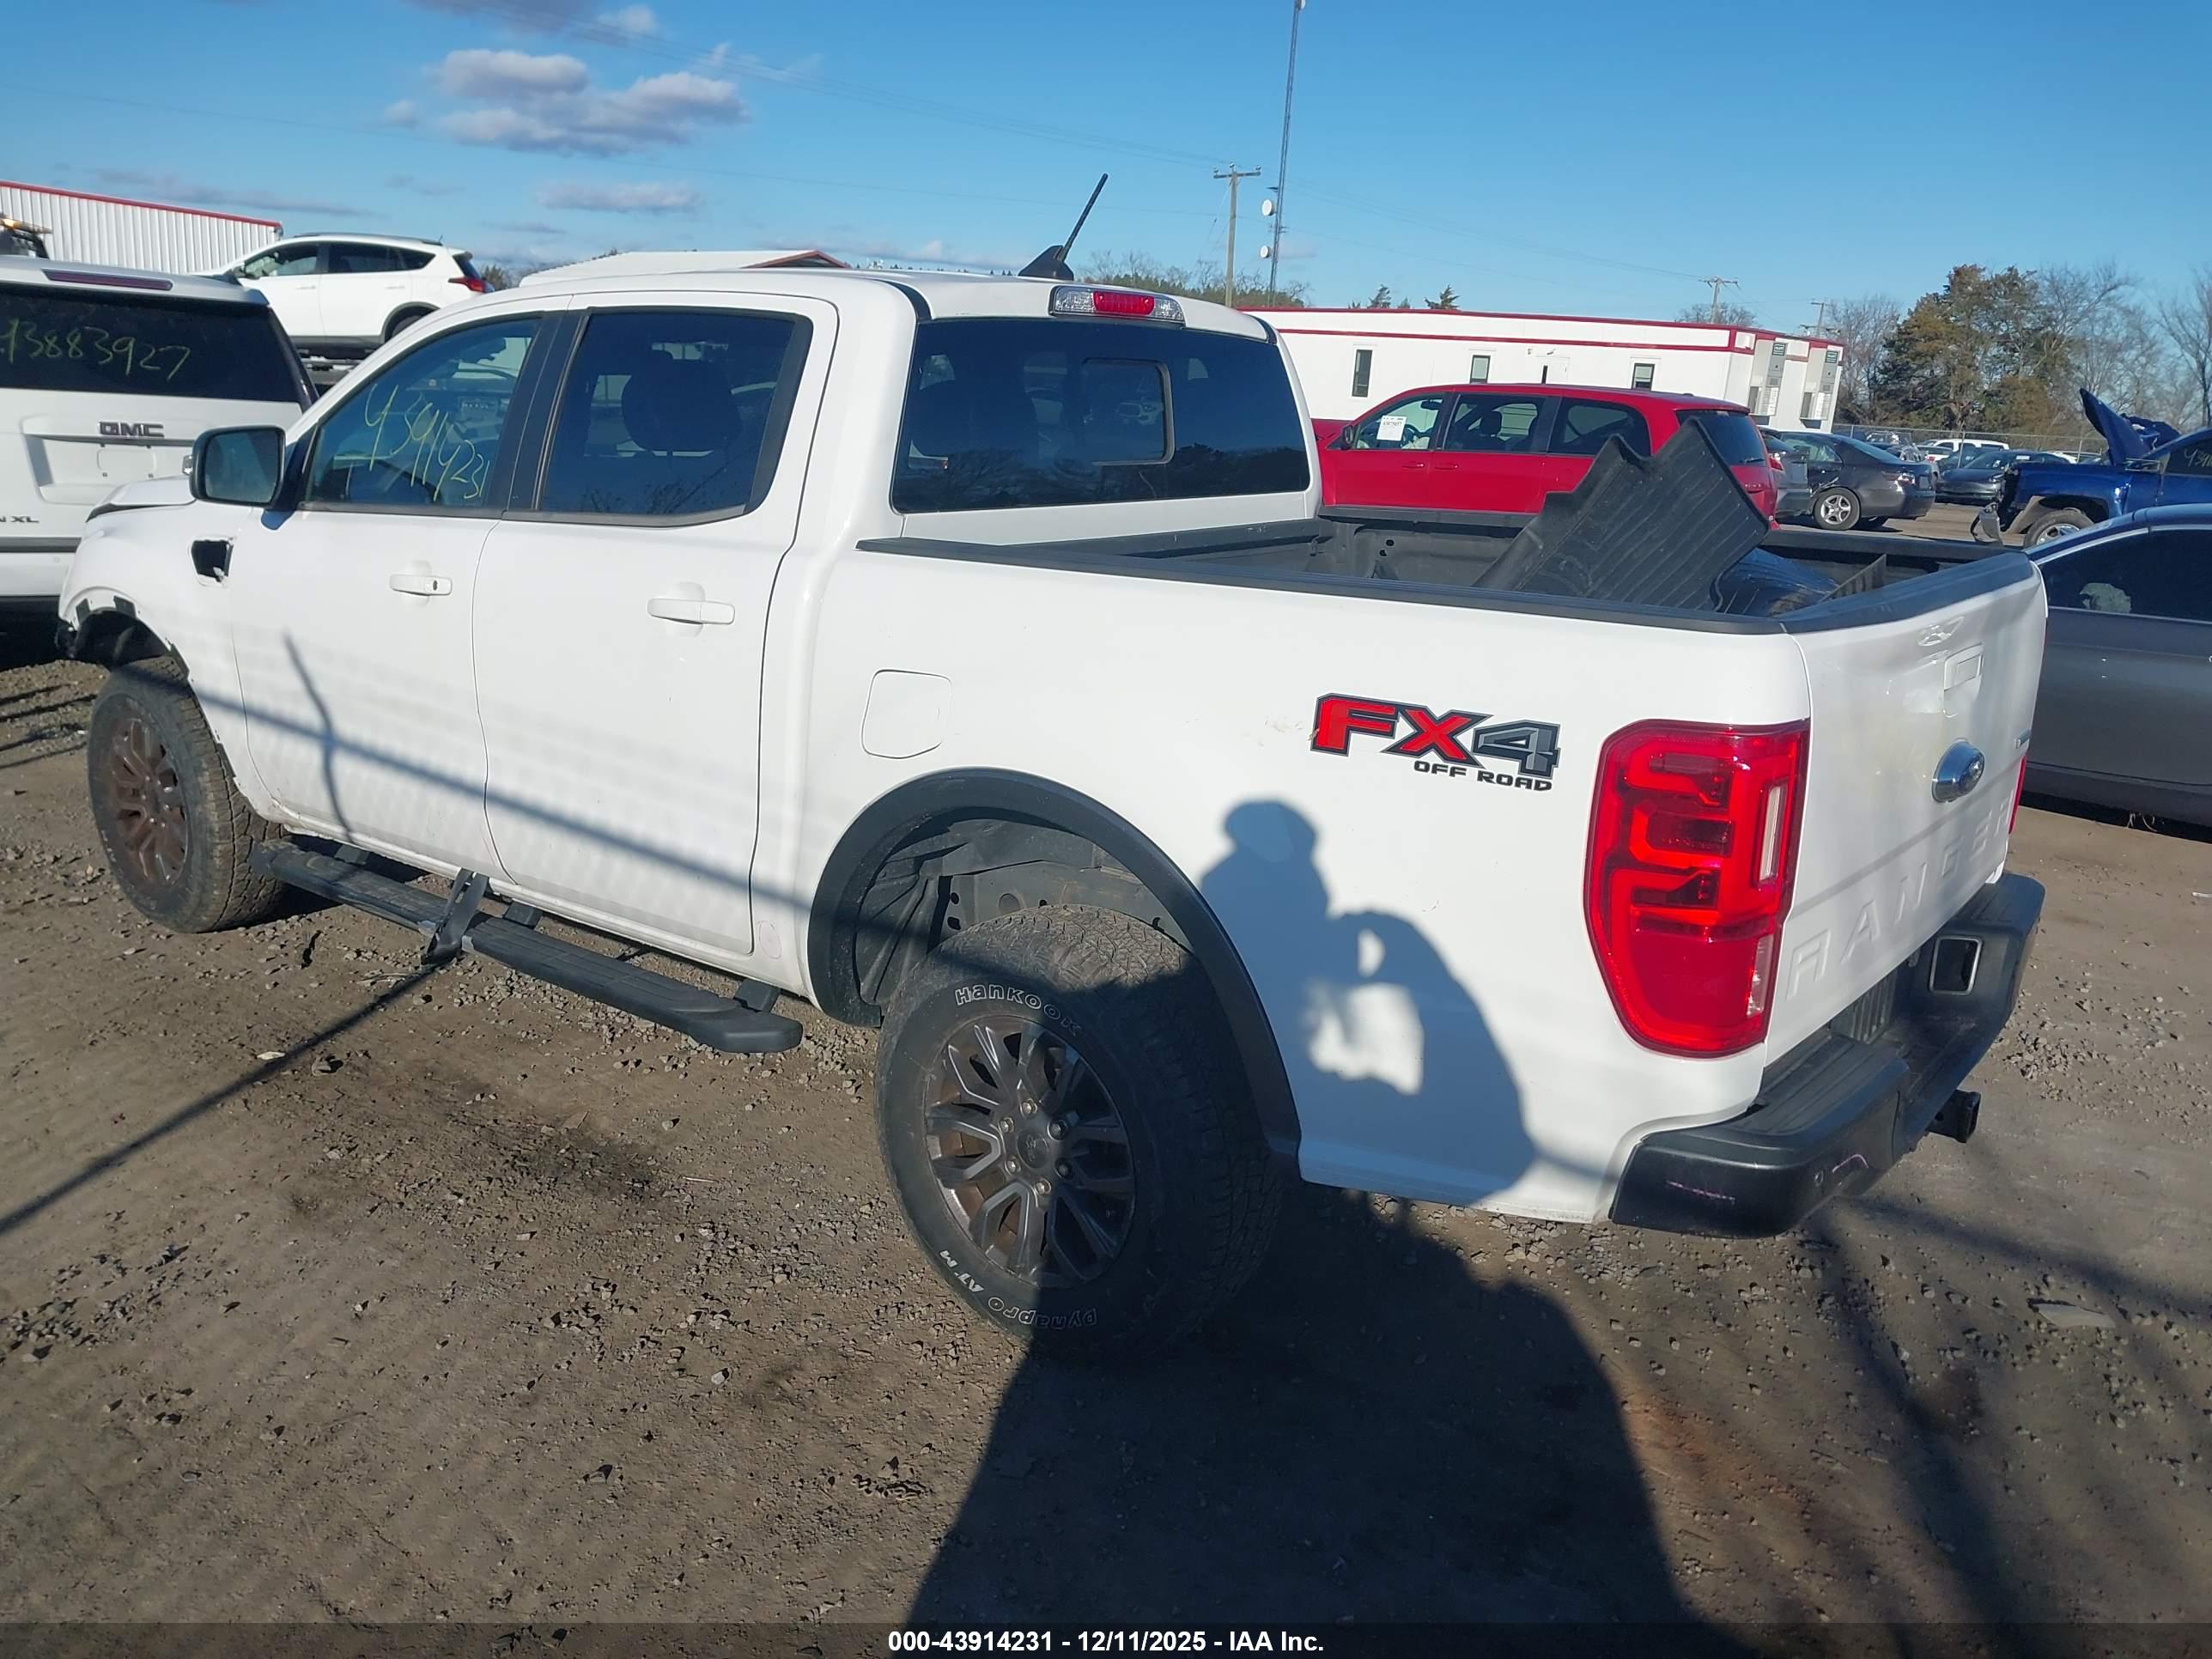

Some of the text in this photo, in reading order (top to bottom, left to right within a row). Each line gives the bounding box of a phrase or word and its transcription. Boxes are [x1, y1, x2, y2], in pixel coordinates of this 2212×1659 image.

[99, 421, 165, 438] GMC
[365, 383, 490, 501] 43914231
[1310, 692, 1562, 781] FX4
[1413, 760, 1553, 792] OFF ROAD
[1786, 795, 2012, 1000] RANGER
